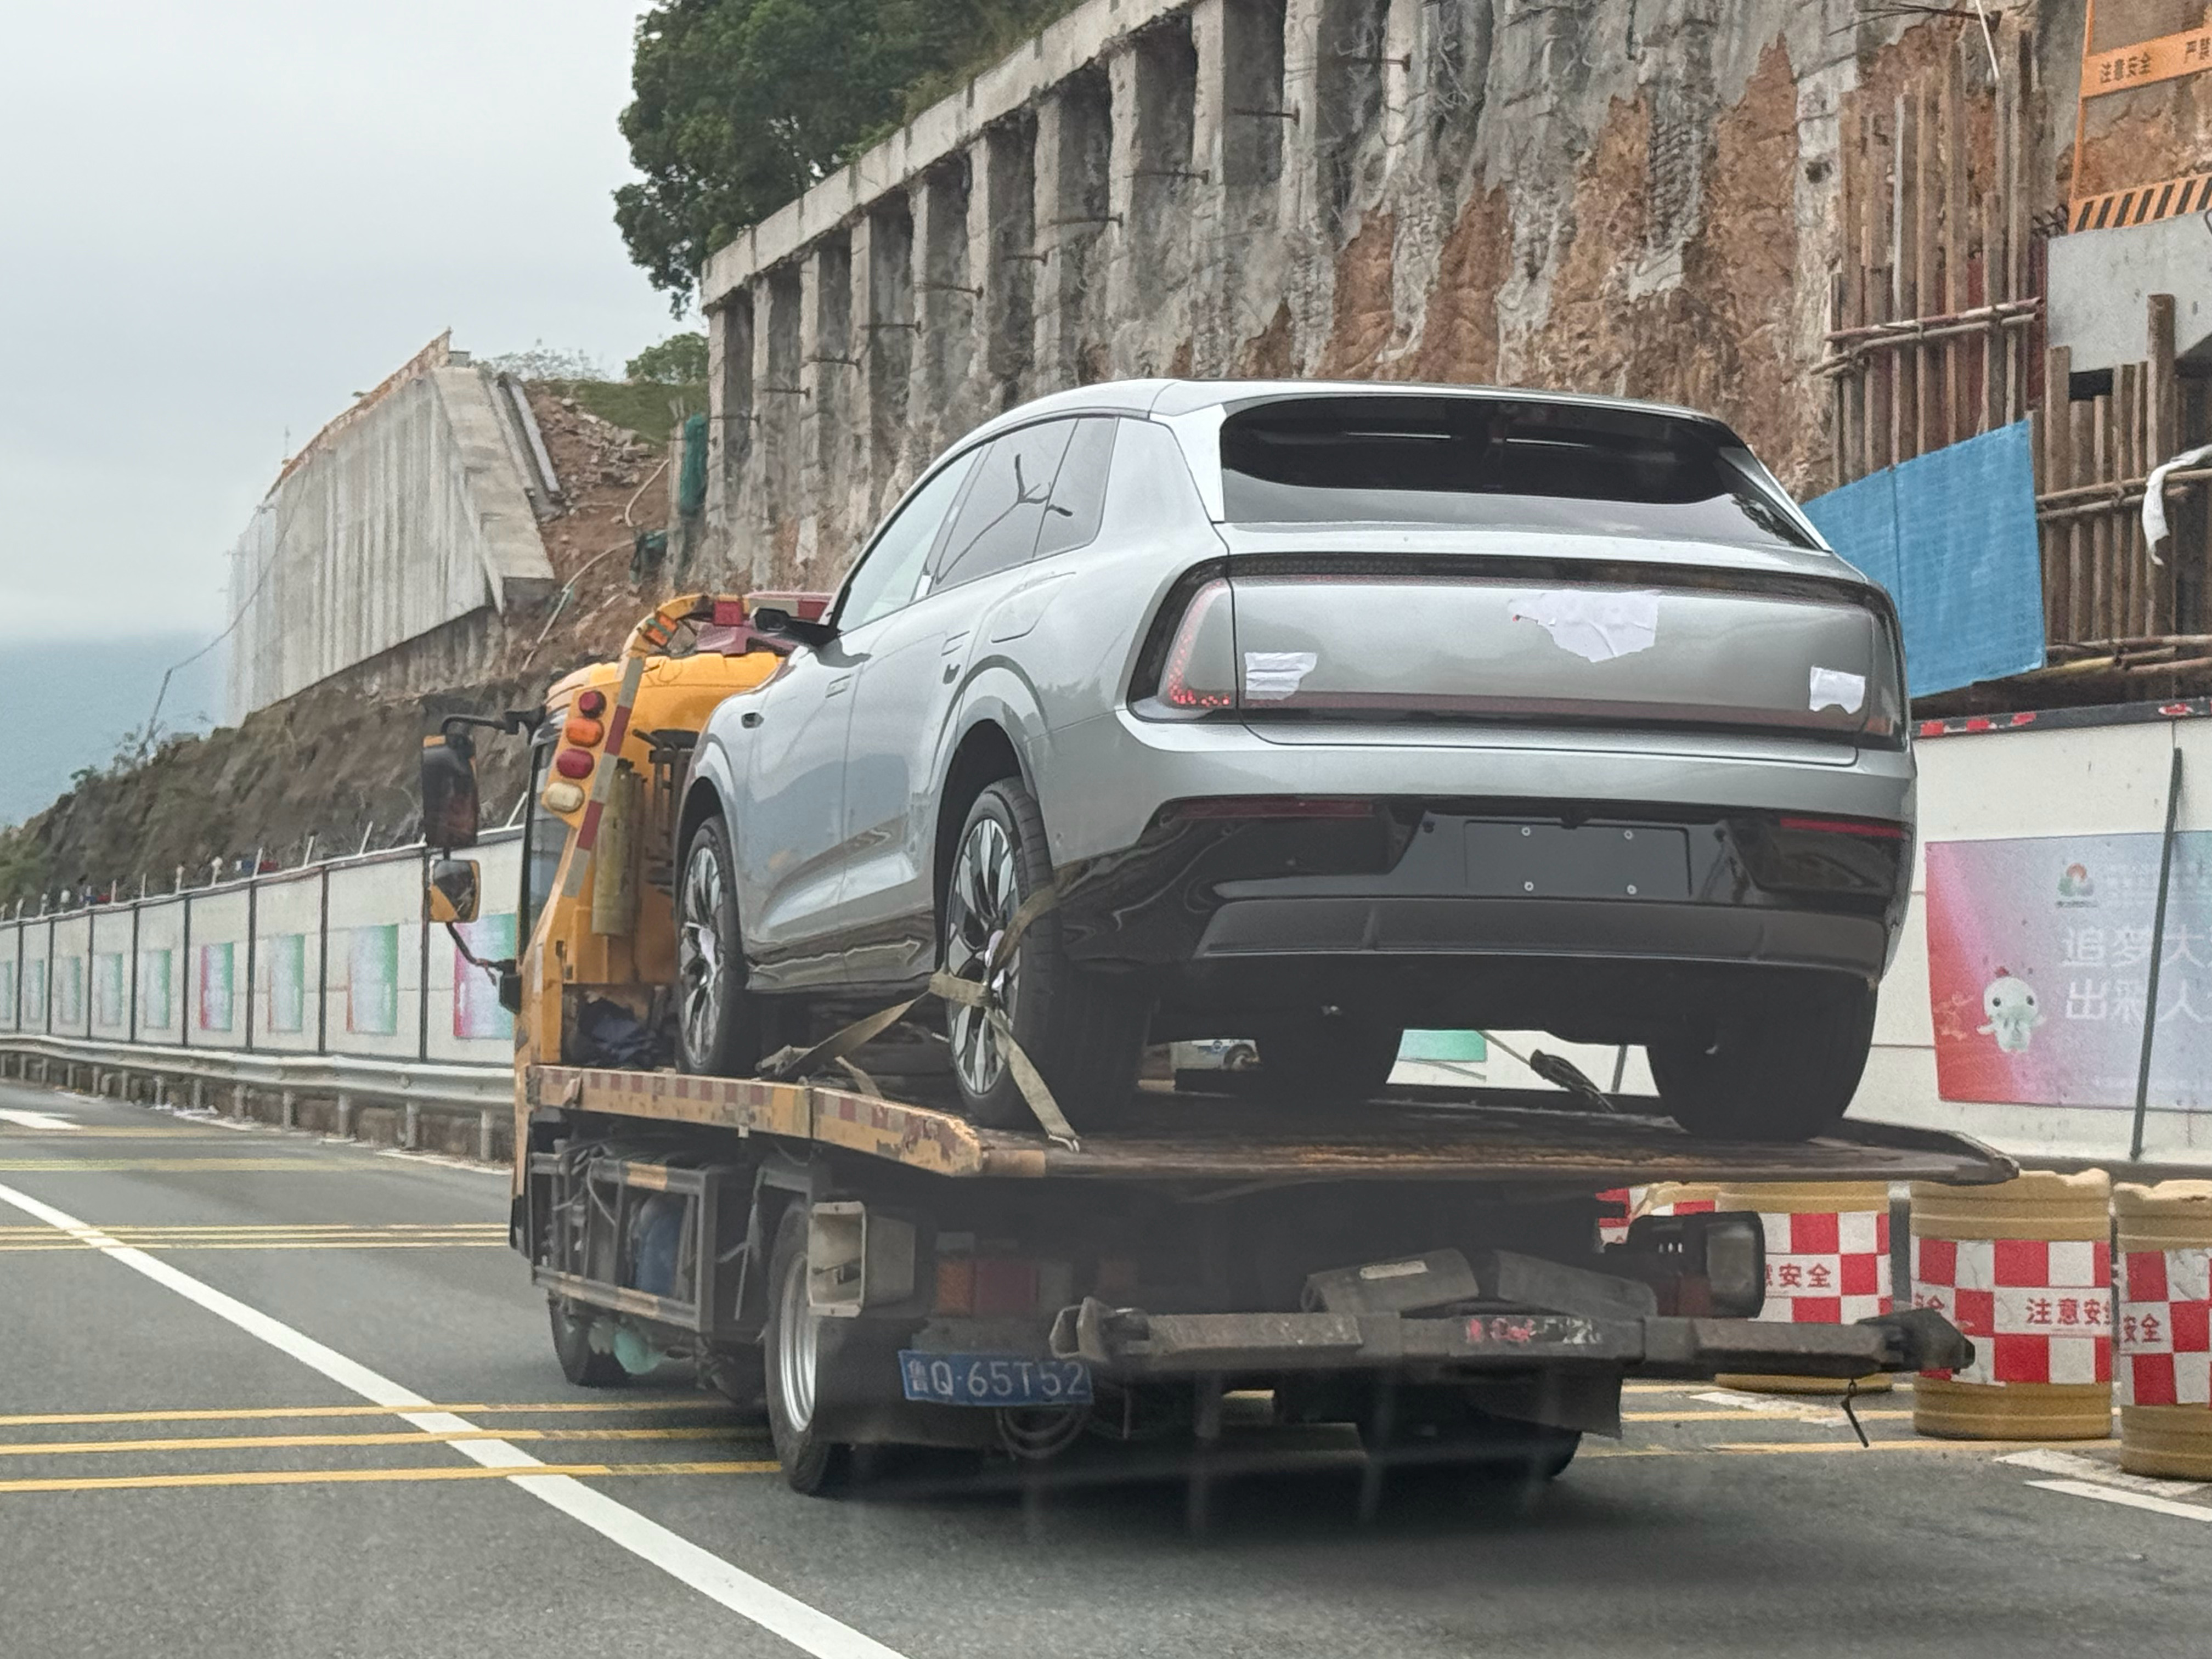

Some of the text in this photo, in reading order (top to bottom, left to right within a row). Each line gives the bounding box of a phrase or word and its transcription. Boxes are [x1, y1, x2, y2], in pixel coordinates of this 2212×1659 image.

[2061, 923, 2212, 969] 追梦大
[2066, 978, 2212, 1024] 出彩人
